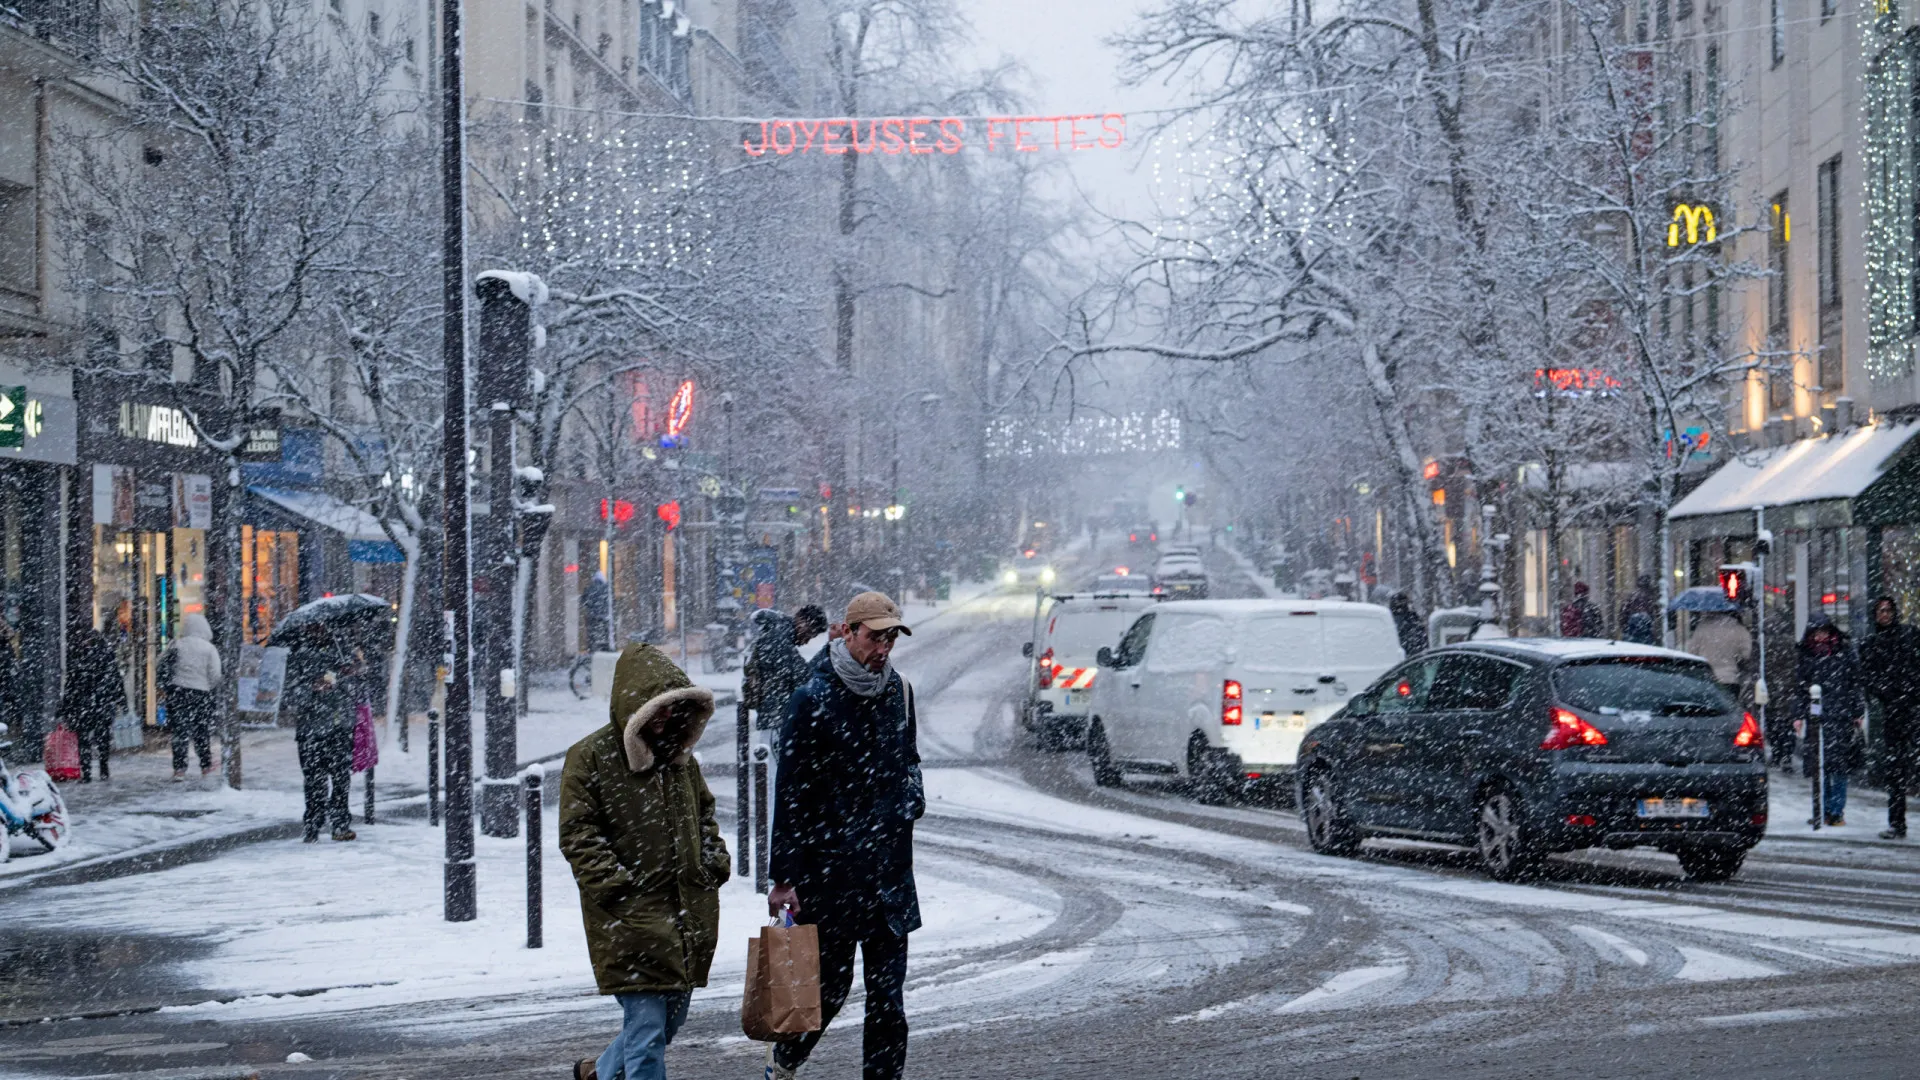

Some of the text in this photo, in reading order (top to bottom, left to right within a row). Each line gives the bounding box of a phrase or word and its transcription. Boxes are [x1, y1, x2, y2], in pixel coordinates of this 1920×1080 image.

[743, 112, 1127, 157] JOYEUSES FETES
[119, 401, 151, 439] ALAIN
